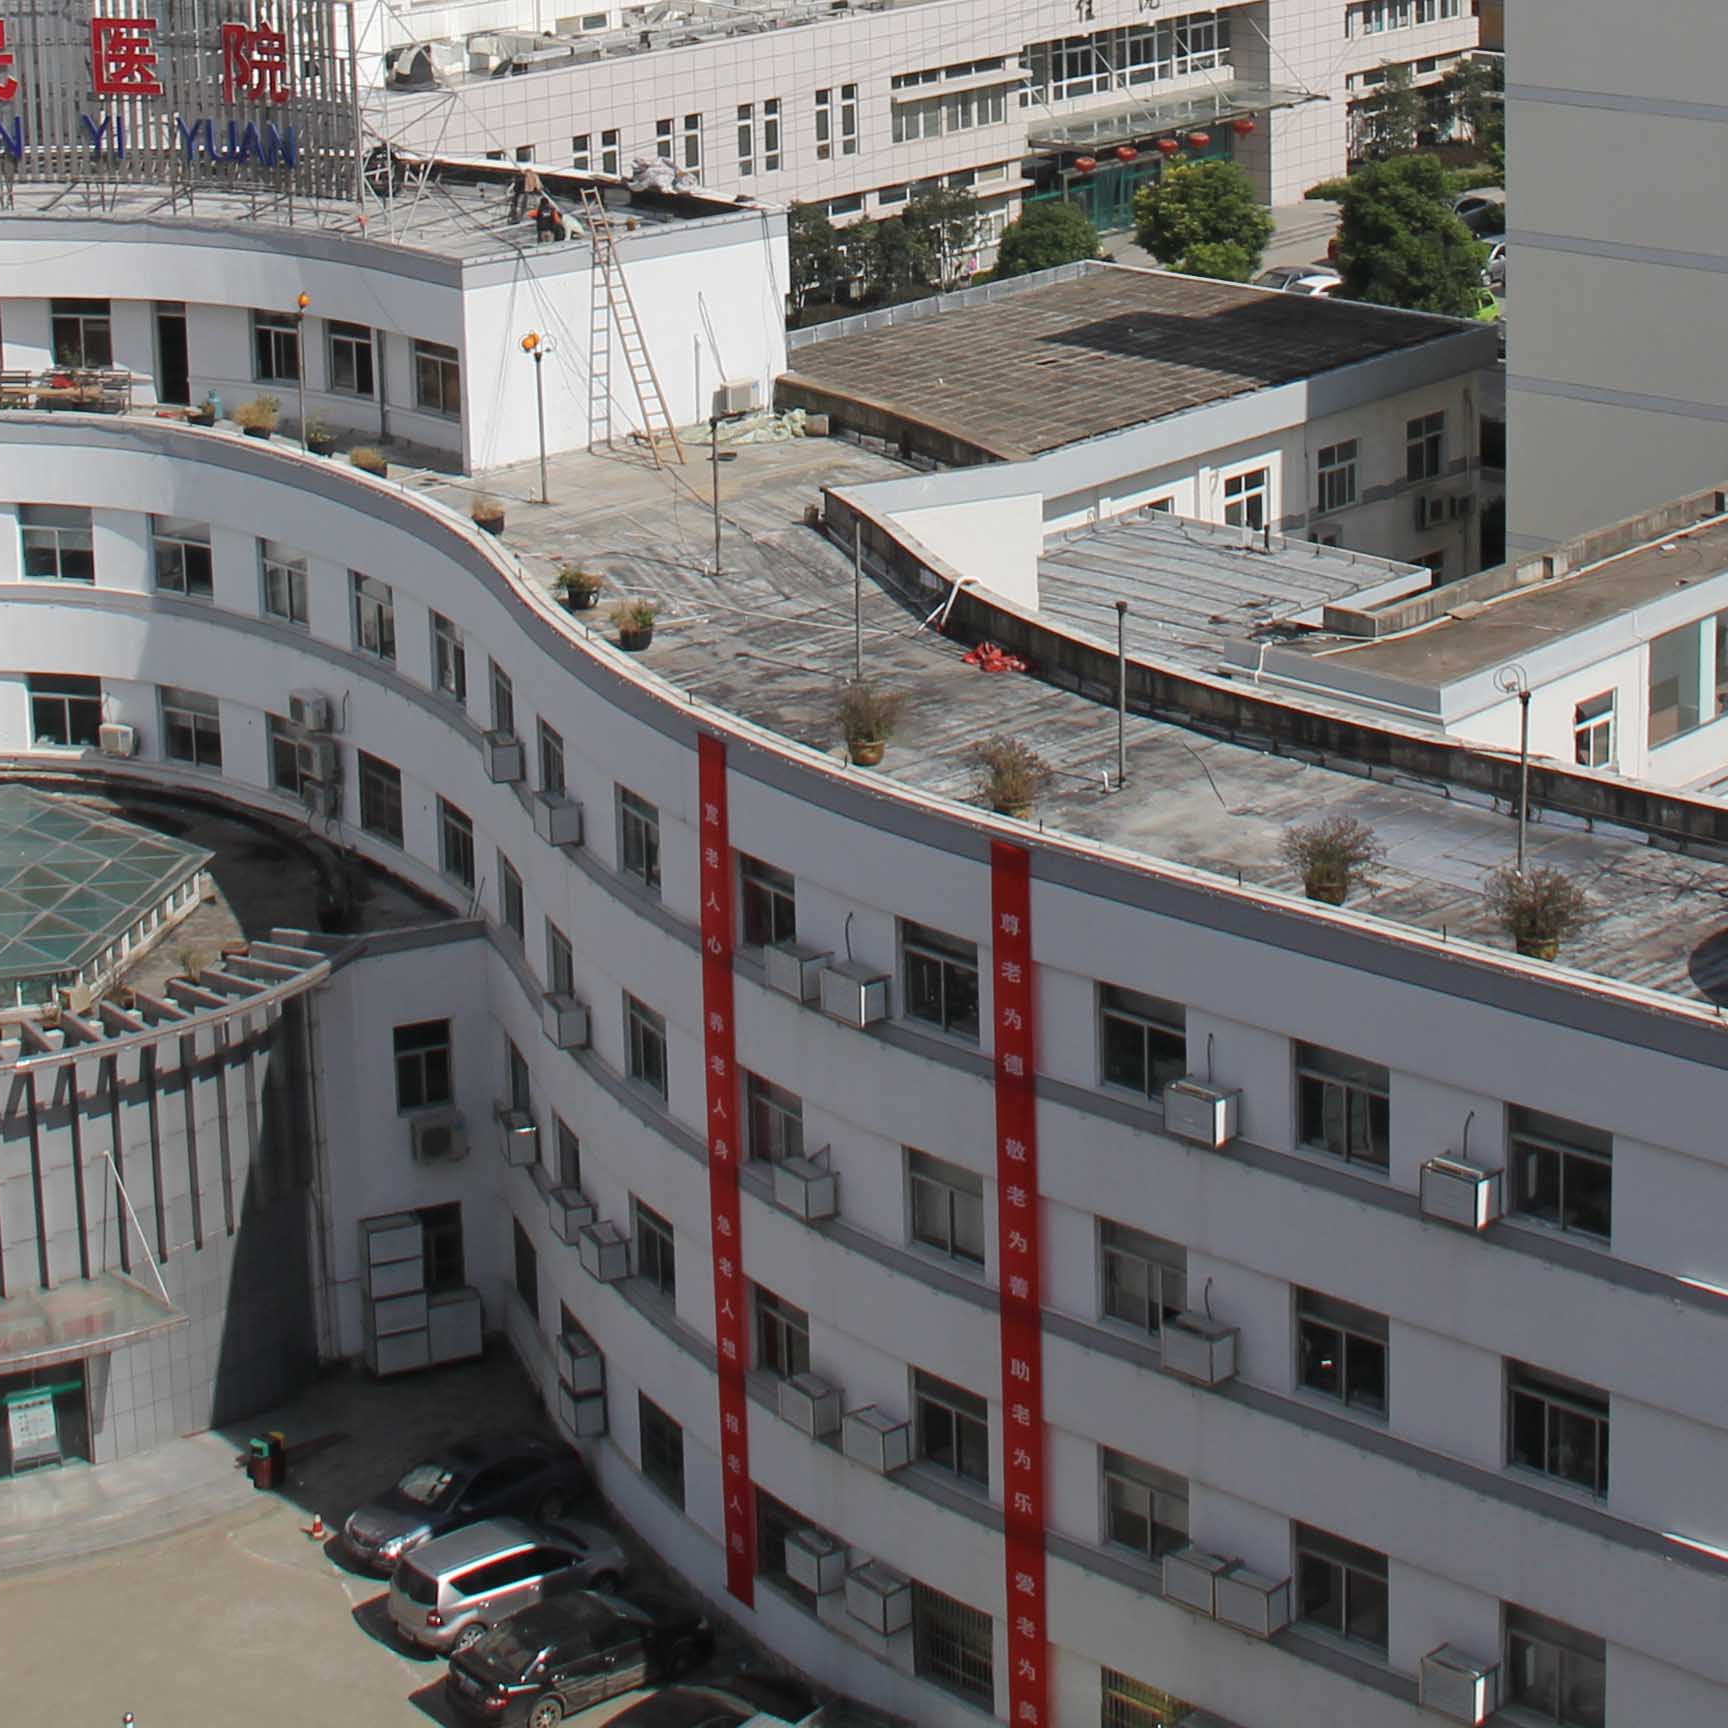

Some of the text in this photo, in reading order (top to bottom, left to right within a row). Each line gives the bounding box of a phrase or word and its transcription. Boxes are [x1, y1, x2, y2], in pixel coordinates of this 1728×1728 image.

[81, 115, 126, 160] YI
[175, 117, 297, 169] YUAN
[999, 912, 1024, 1078] 尊老为德
[1005, 1137, 1029, 1300] 敬老为善
[1010, 1358, 1033, 1515] 助老为乐
